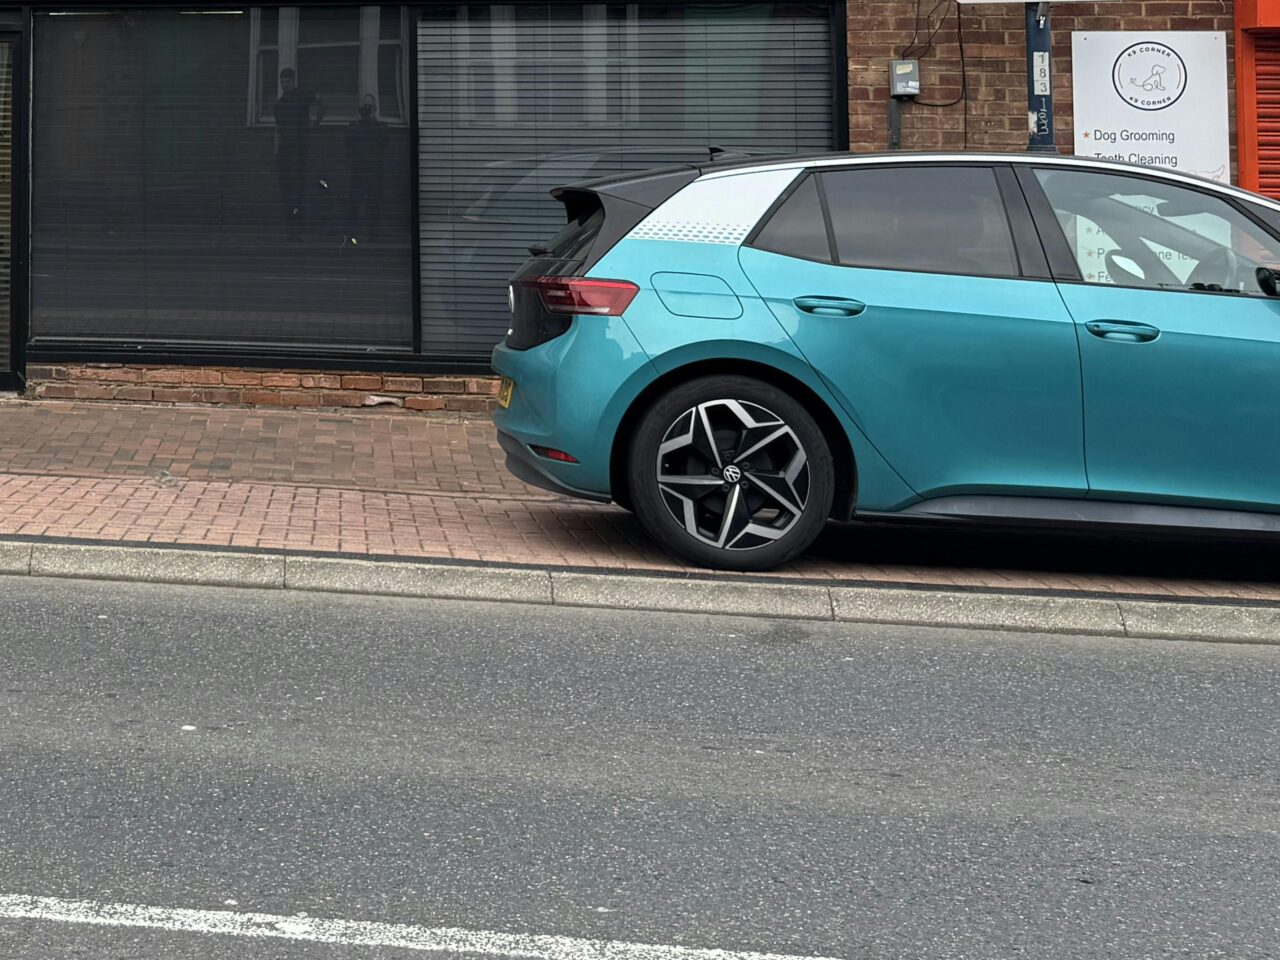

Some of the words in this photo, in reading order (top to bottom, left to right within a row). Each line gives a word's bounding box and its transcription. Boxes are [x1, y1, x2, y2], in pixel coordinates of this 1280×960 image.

[1140, 46, 1171, 57] CORNER
[1094, 129, 1117, 144] Dog
[1120, 129, 1175, 144] Grooming
[1128, 153, 1178, 168] Cleaning
